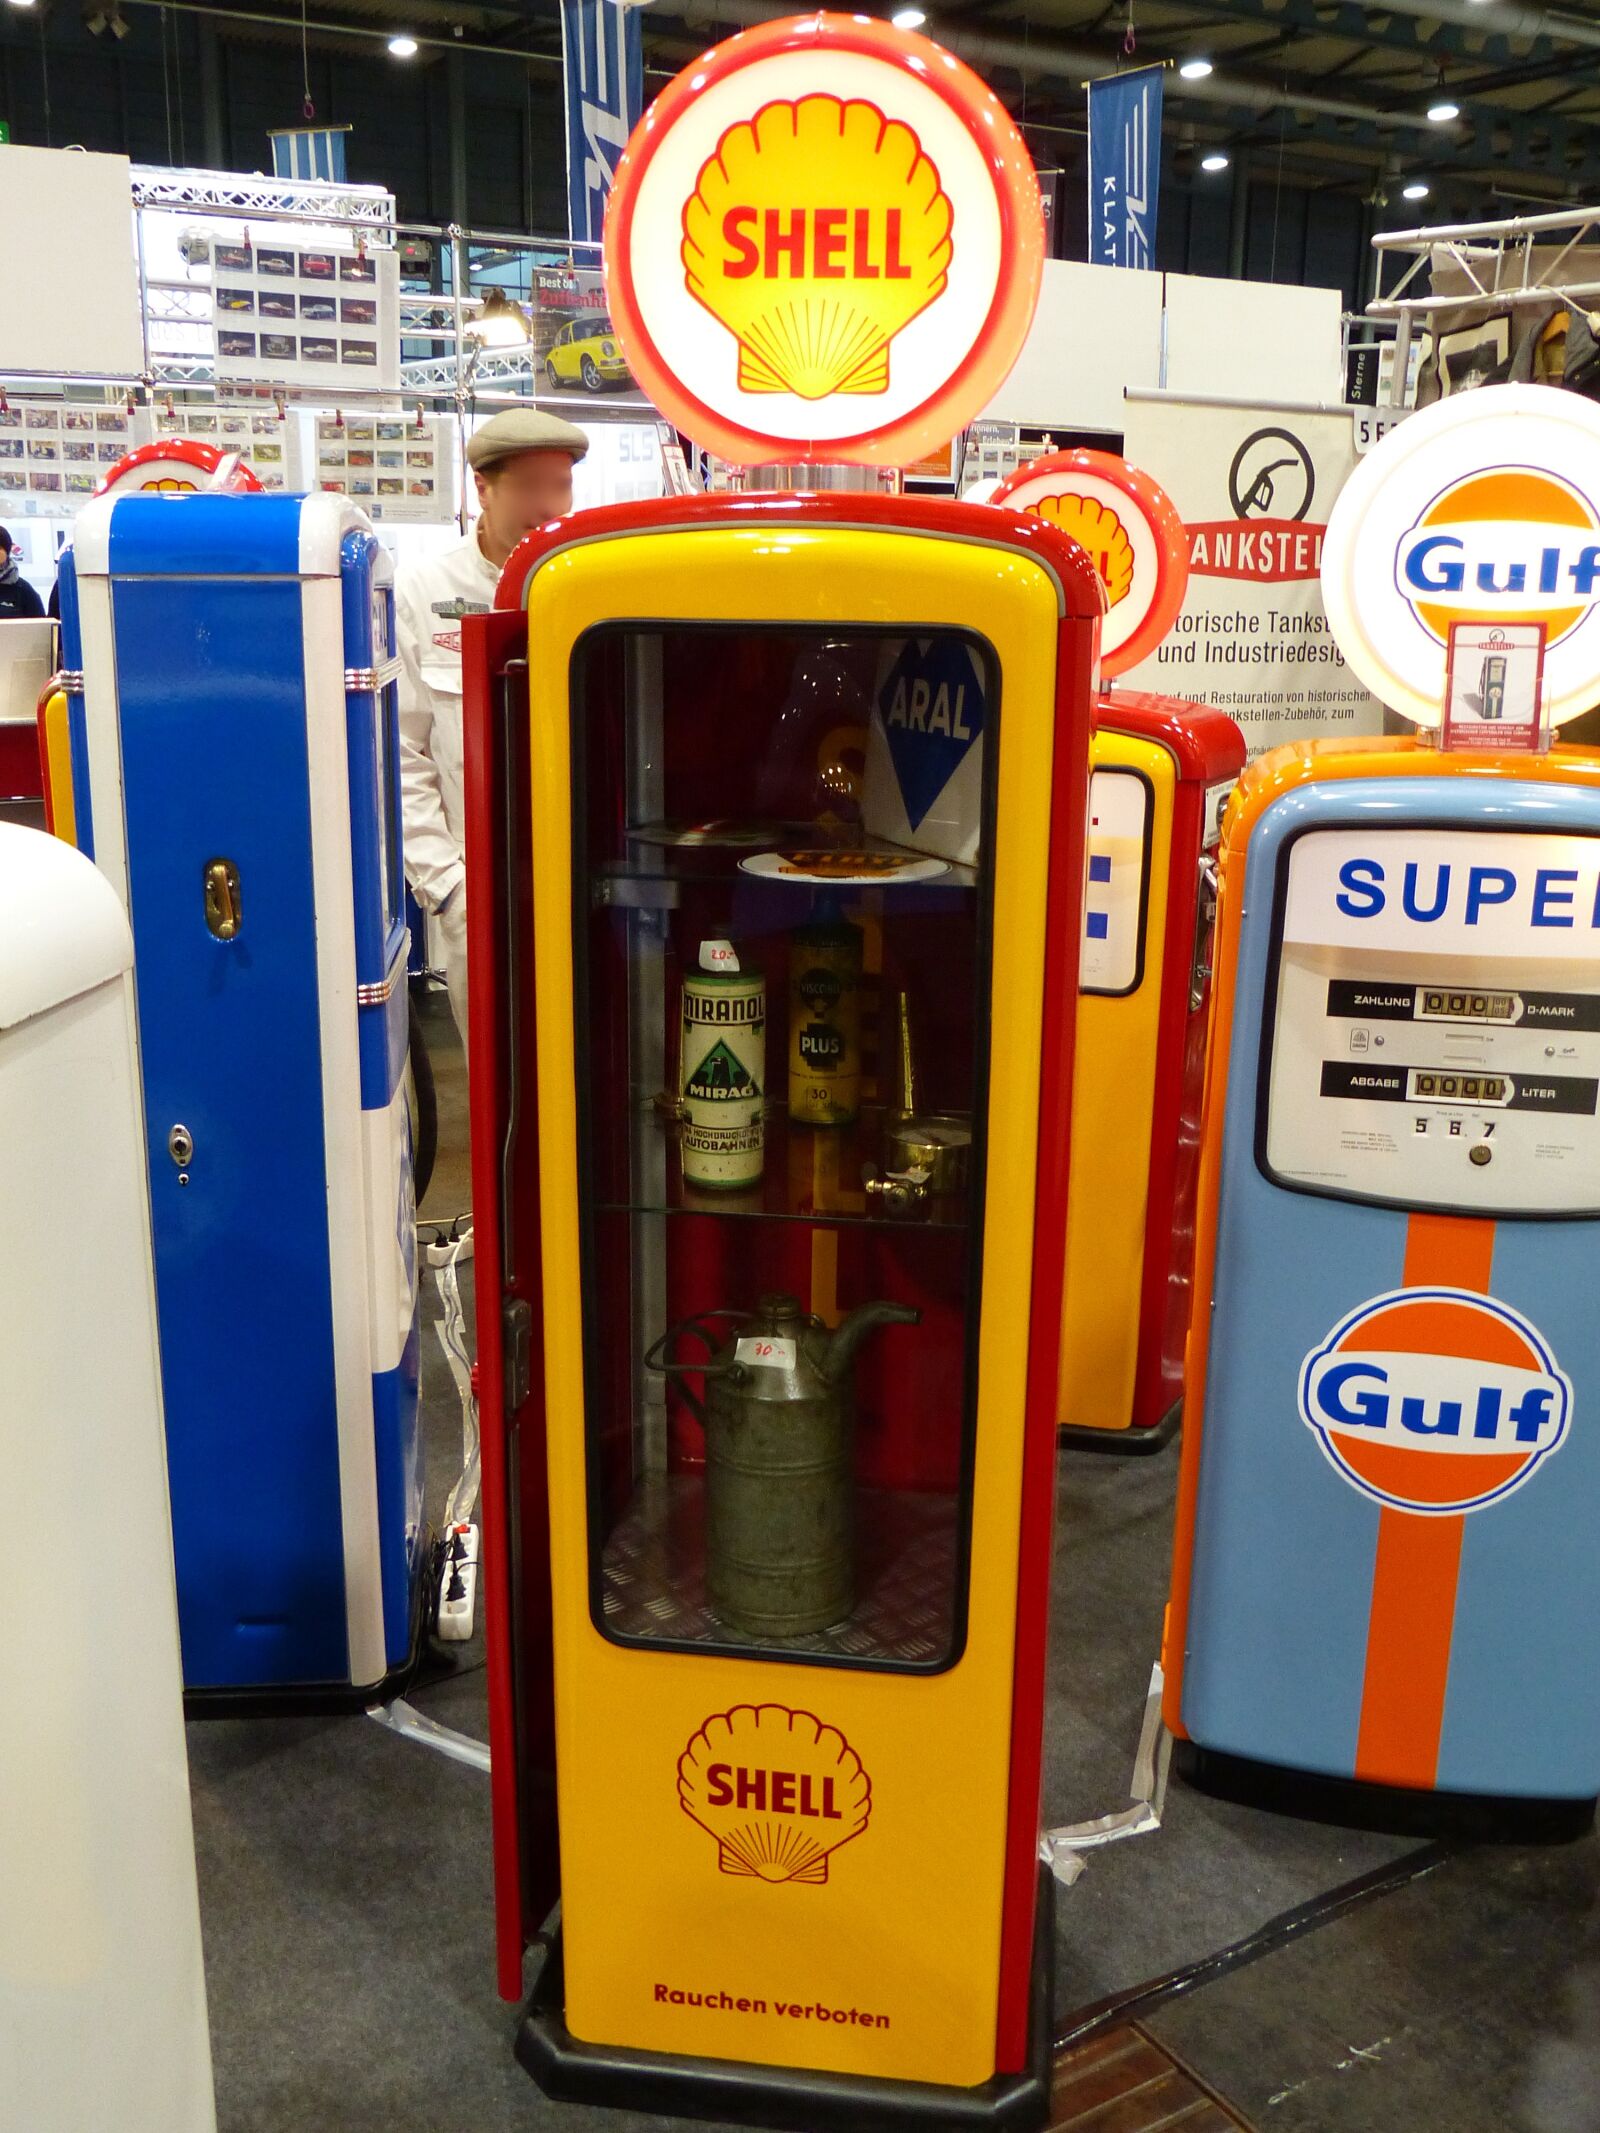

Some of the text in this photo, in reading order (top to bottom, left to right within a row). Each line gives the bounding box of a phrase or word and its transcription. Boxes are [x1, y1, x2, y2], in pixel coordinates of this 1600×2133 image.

[722, 206, 912, 279] SHELL
[539, 276, 561, 289] Best
[1352, 353, 1366, 400] Sterne
[620, 431, 653, 462] SLS
[1405, 535, 1600, 594] Gulf
[1158, 641, 1196, 663] und
[1211, 691, 1283, 703] Restauration
[1287, 692, 1304, 703] von
[1308, 689, 1371, 702] historischen
[887, 675, 971, 741] ARAL
[1331, 709, 1354, 720] zum
[1353, 995, 1410, 1008] ZAHLUNG
[1527, 1005, 1575, 1018] D-MARK
[801, 1036, 840, 1054] PLUS
[690, 1084, 754, 1099] MIRAG
[811, 1089, 828, 1100] 30
[1350, 1076, 1400, 1089] ABGABE
[1521, 1087, 1556, 1099] LITER
[1416, 1118, 1428, 1133] 5
[1483, 1121, 1496, 1138] 7
[1317, 1362, 1554, 1442] Gulf
[707, 1763, 842, 1819] SHELL
[654, 1984, 890, 2029] Rauchen verboten
